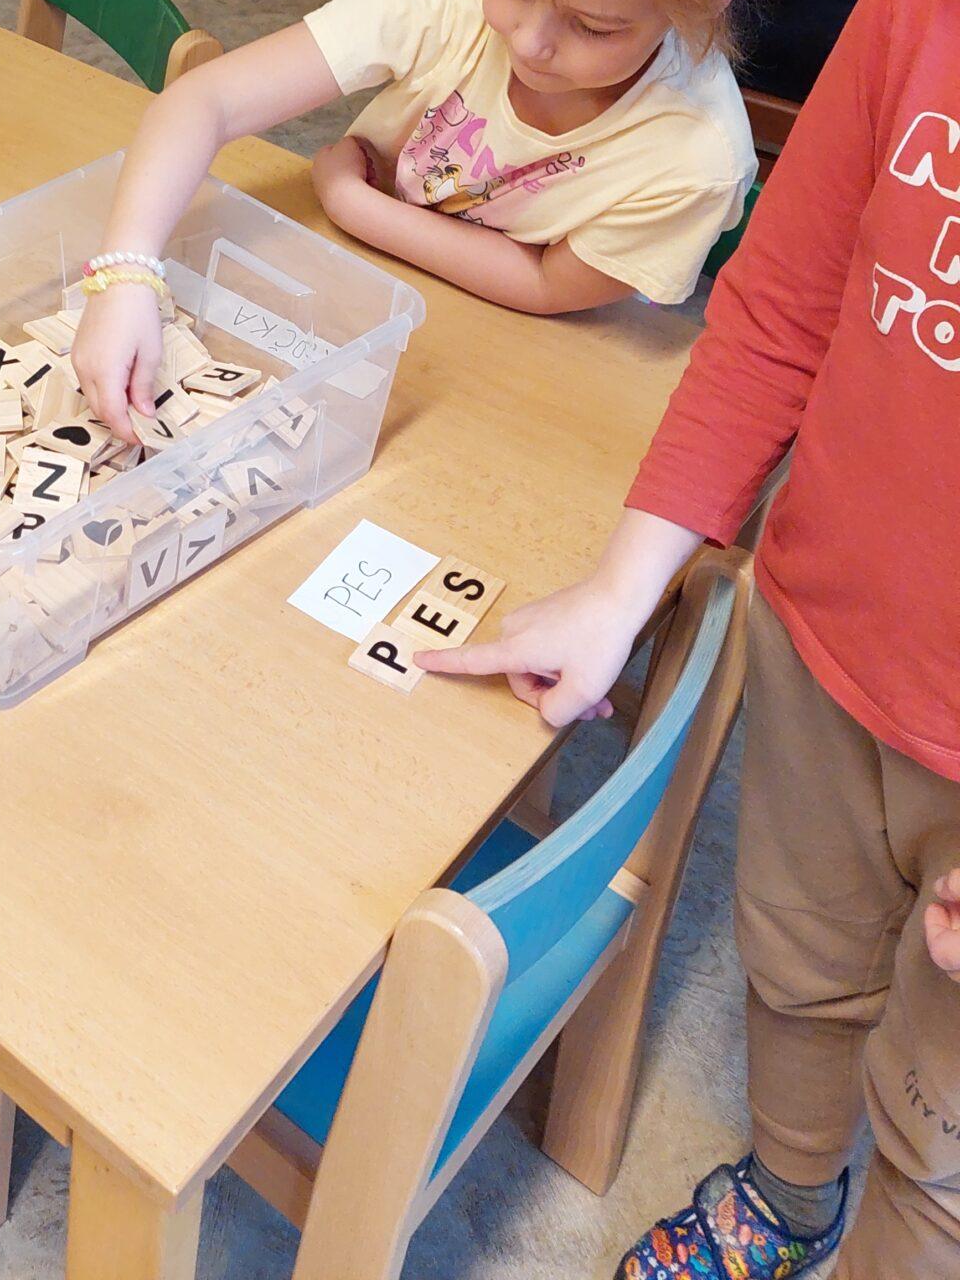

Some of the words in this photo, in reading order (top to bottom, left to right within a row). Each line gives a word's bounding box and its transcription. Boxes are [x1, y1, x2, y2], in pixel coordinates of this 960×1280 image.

[203, 367, 245, 382] R
[323, 560, 392, 618] PES
[366, 570, 486, 675] PES
